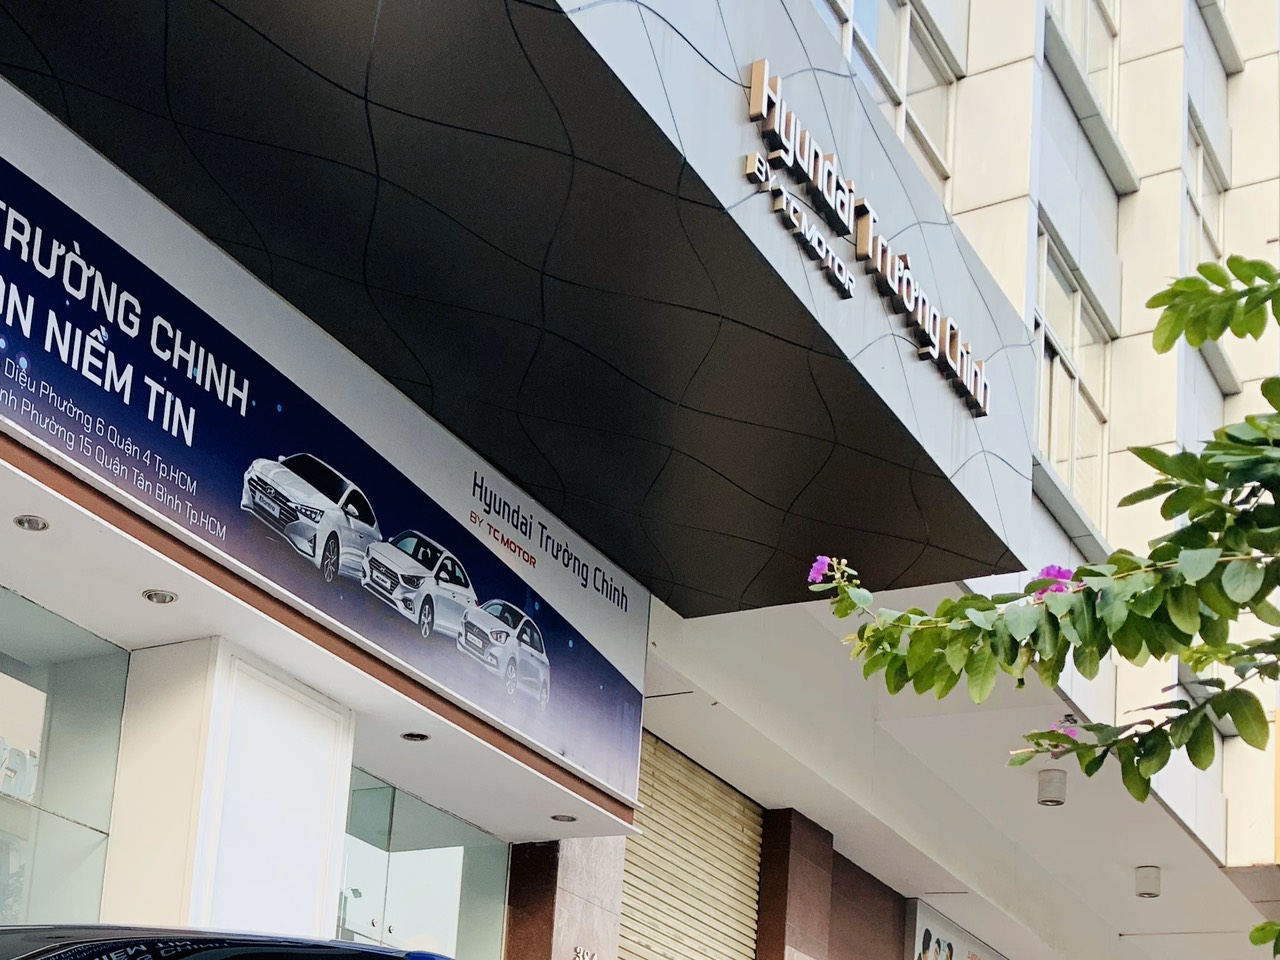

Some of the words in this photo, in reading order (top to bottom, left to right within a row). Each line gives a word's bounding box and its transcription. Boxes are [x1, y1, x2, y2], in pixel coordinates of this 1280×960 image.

[746, 152, 777, 192] BY
[750, 58, 855, 237] Hyundai
[939, 317, 990, 417] Chinh
[4, 358, 36, 394] Diệu
[40, 381, 92, 435] Phường
[95, 416, 105, 436] 6
[107, 425, 140, 461] Quận
[142, 449, 152, 466] 4
[154, 454, 197, 497] Tp.HCM
[44, 309, 133, 405] NIỀM
[144, 376, 195, 447] TIN
[150, 315, 249, 416] CHINH
[20, 399, 75, 450] Phường
[78, 434, 93, 456] 15
[95, 446, 128, 480] Quận
[131, 466, 153, 497] Tân
[155, 484, 181, 513] Bình
[185, 503, 227, 541] Tp.HCM
[470, 510, 484, 527] BY
[472, 471, 533, 540] Hyundai
[538, 521, 589, 589] Trường
[593, 566, 629, 613] Chinh
